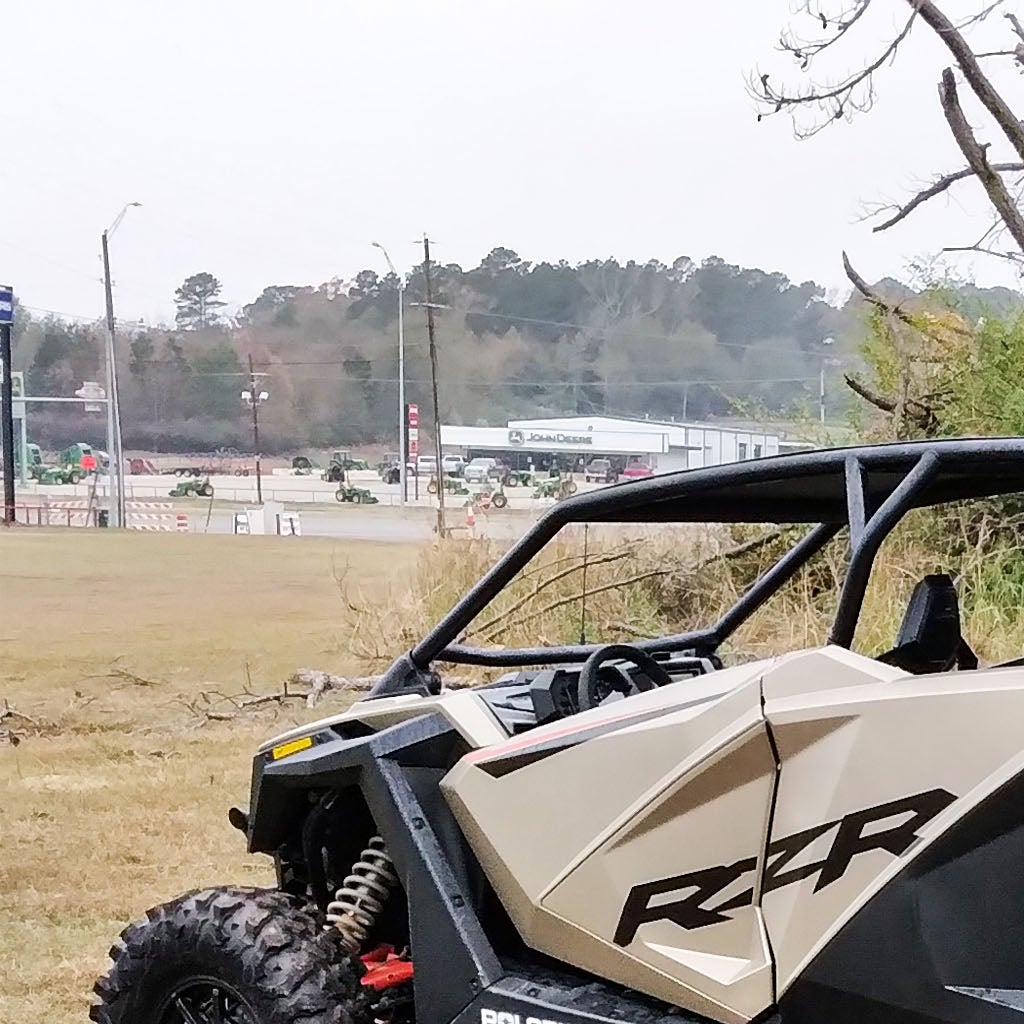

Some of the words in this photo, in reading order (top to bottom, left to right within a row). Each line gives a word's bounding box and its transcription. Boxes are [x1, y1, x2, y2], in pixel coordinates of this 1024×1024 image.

[527, 432, 556, 442] JOHN
[557, 433, 592, 444] DEERE
[613, 787, 960, 947] RZR
